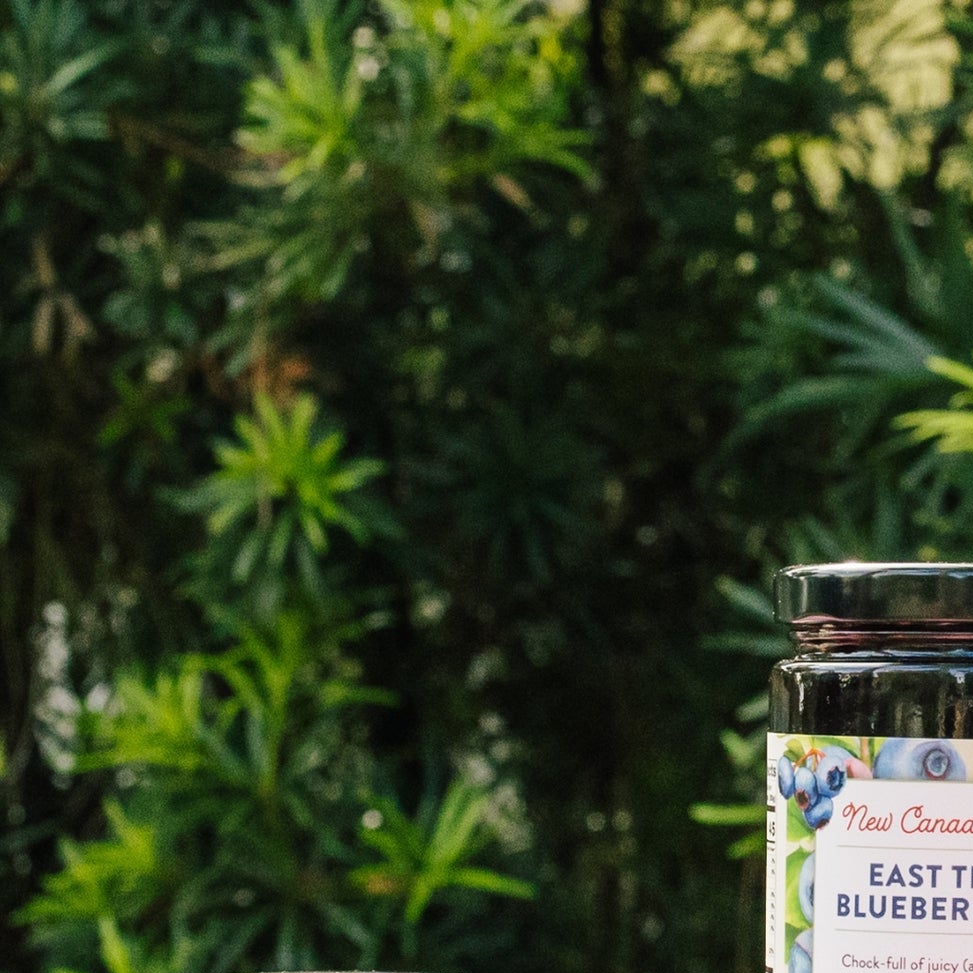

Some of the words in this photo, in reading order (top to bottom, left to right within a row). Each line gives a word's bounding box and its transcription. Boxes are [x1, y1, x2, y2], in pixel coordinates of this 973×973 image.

[841, 801, 894, 832] New
[869, 862, 943, 889] EAST
[841, 953, 907, 971] Chock-full
[910, 956, 926, 971] of
